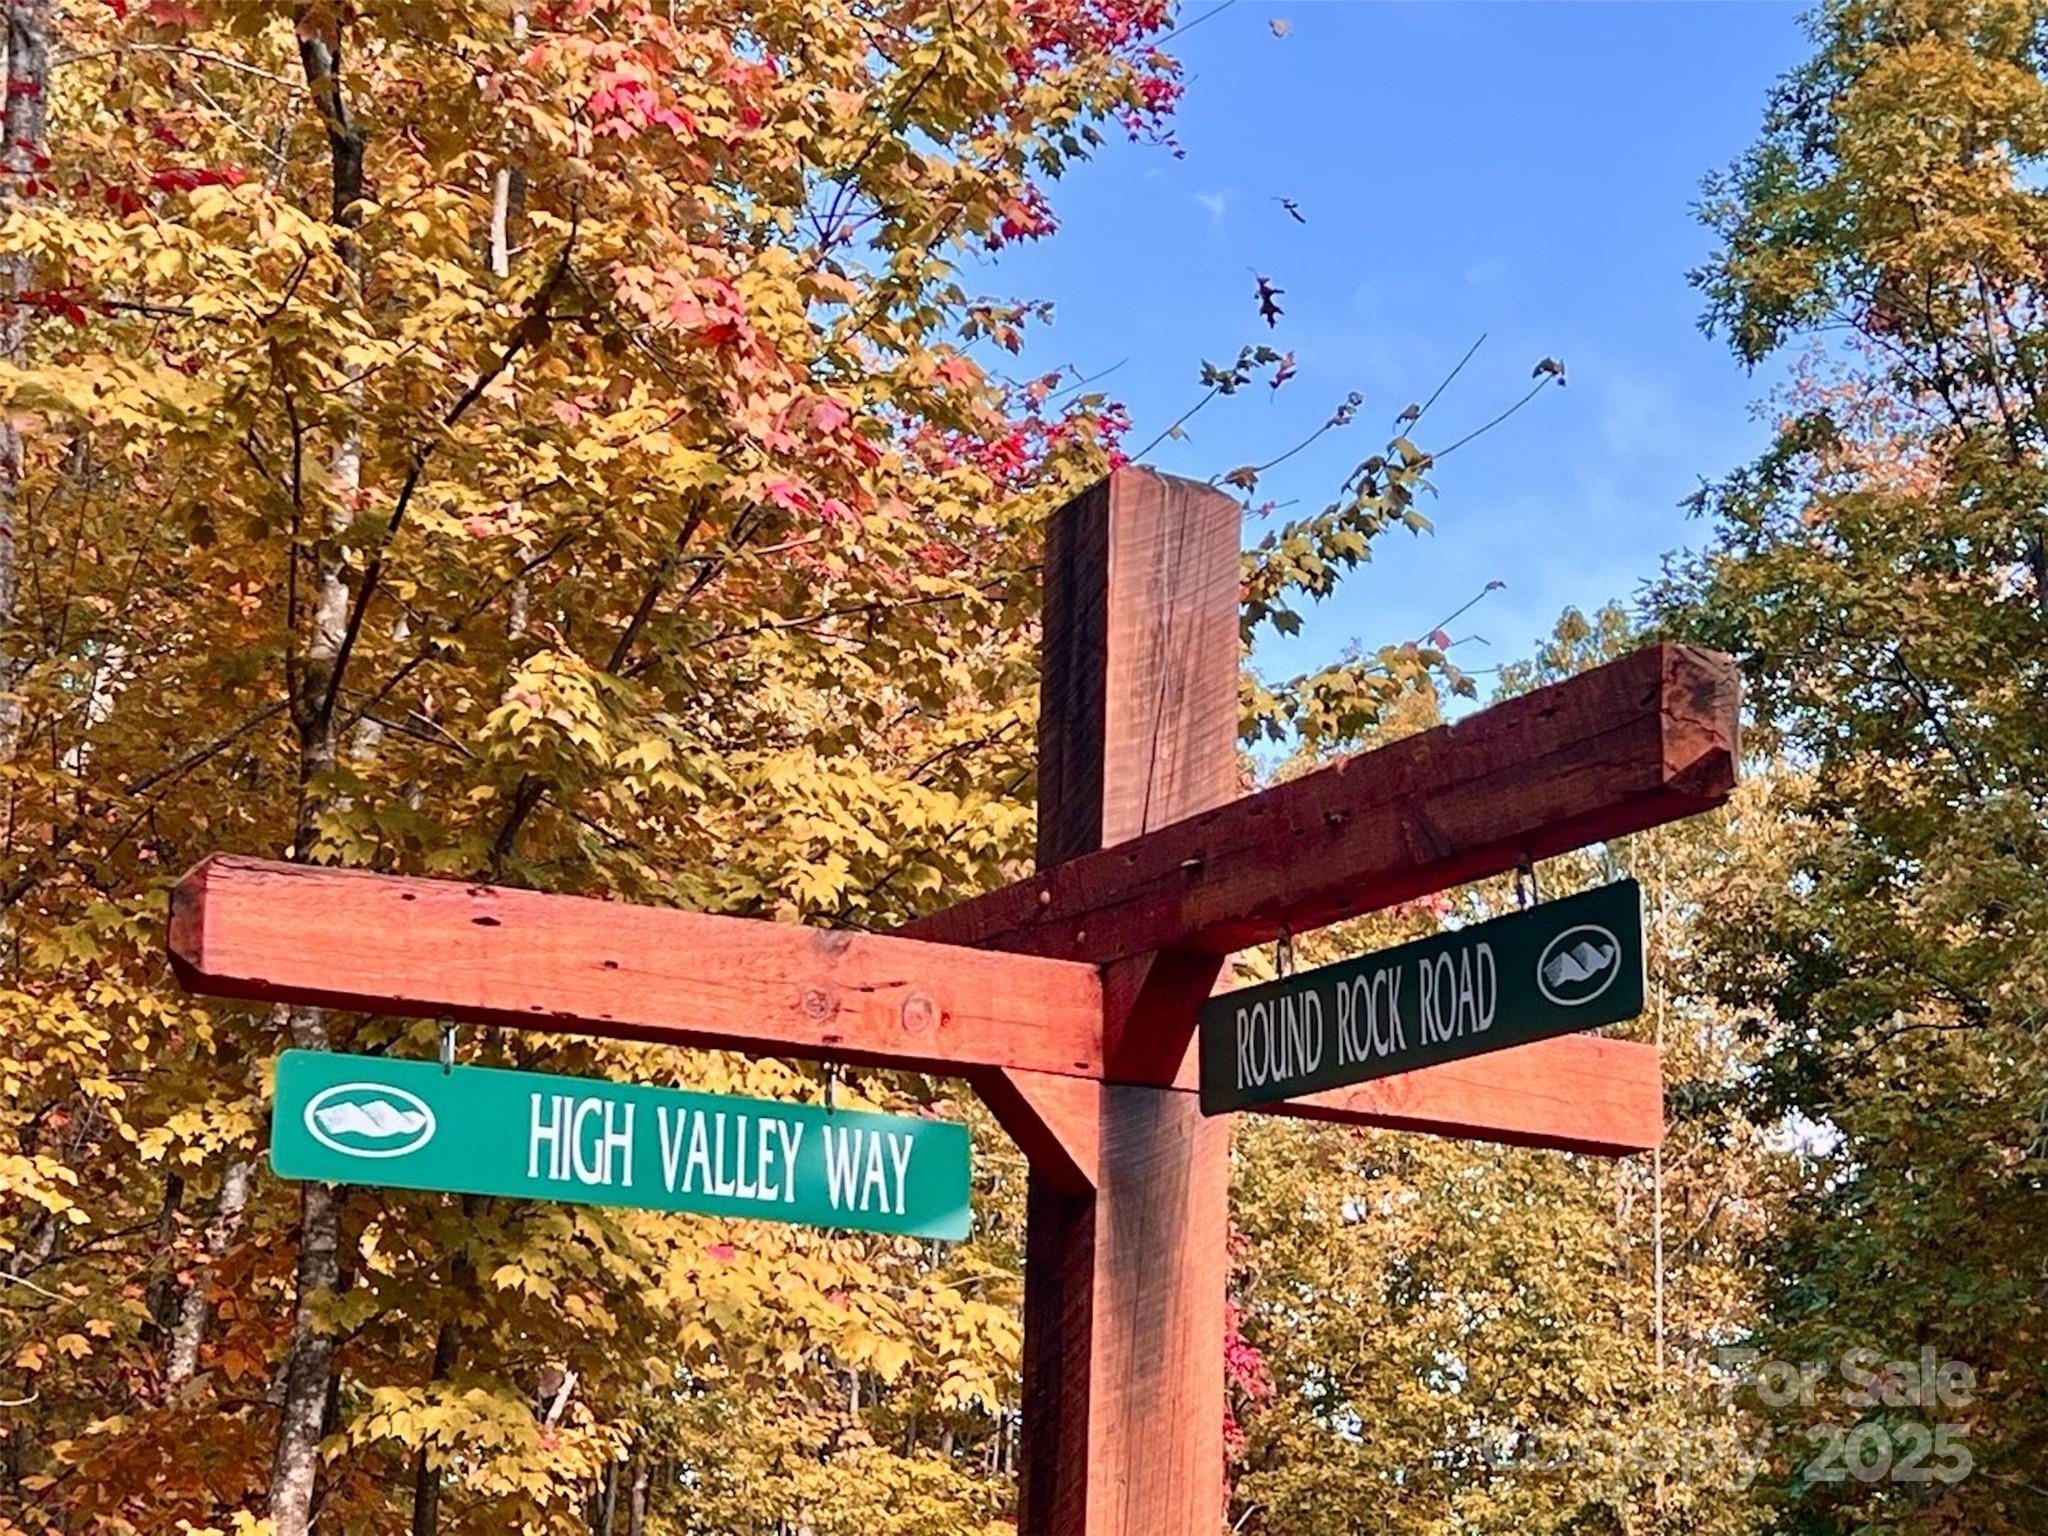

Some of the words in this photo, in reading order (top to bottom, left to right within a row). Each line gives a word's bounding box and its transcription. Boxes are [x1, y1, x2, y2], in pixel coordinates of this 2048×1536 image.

[1237, 989, 1323, 1088] ROUND
[1336, 966, 1406, 1066] ROCK
[1420, 942, 1496, 1047] ROAD
[528, 1093, 635, 1186] HIGH
[657, 1106, 803, 1203] VALLEY
[823, 1125, 913, 1215] WAY
